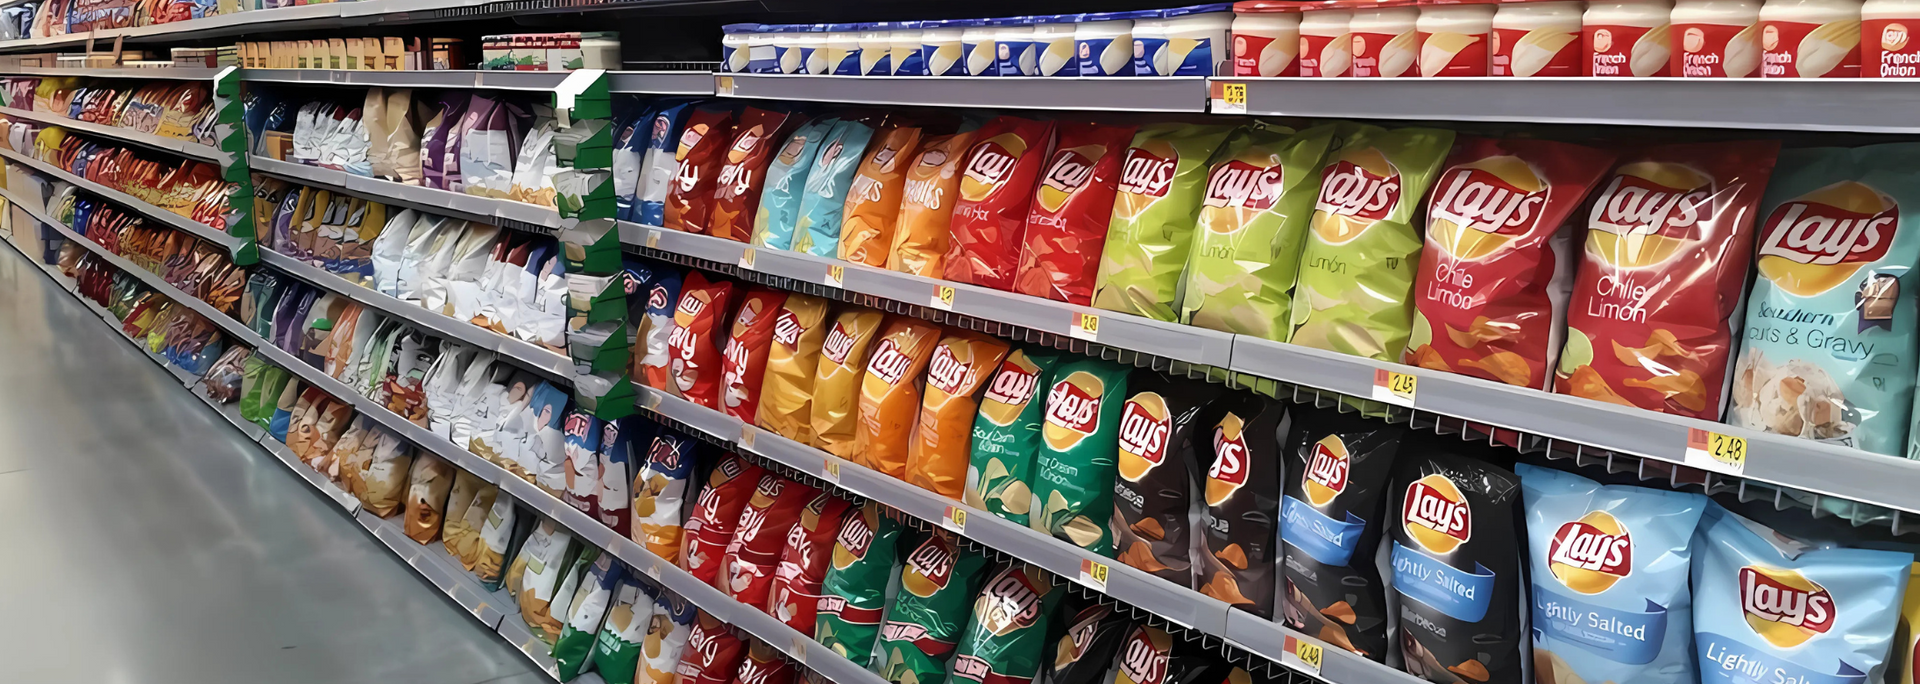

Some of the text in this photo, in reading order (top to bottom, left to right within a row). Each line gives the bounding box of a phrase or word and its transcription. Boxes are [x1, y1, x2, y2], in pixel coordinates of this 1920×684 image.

[1430, 169, 1544, 234] Lay's
[1588, 175, 1700, 236] Lay's
[1758, 202, 1895, 265] Lay's
[1587, 295, 1646, 324] Limón
[1597, 274, 1648, 300] Chile
[1786, 327, 1799, 345] &
[1806, 328, 1875, 360] Gravy
[1307, 445, 1348, 488] Lay's
[1406, 483, 1468, 534] Lay's
[1553, 523, 1630, 571] Lay's
[1744, 569, 1829, 627] Lay's
[1588, 612, 1646, 642] Salted
[1707, 641, 1769, 683] Lightly
